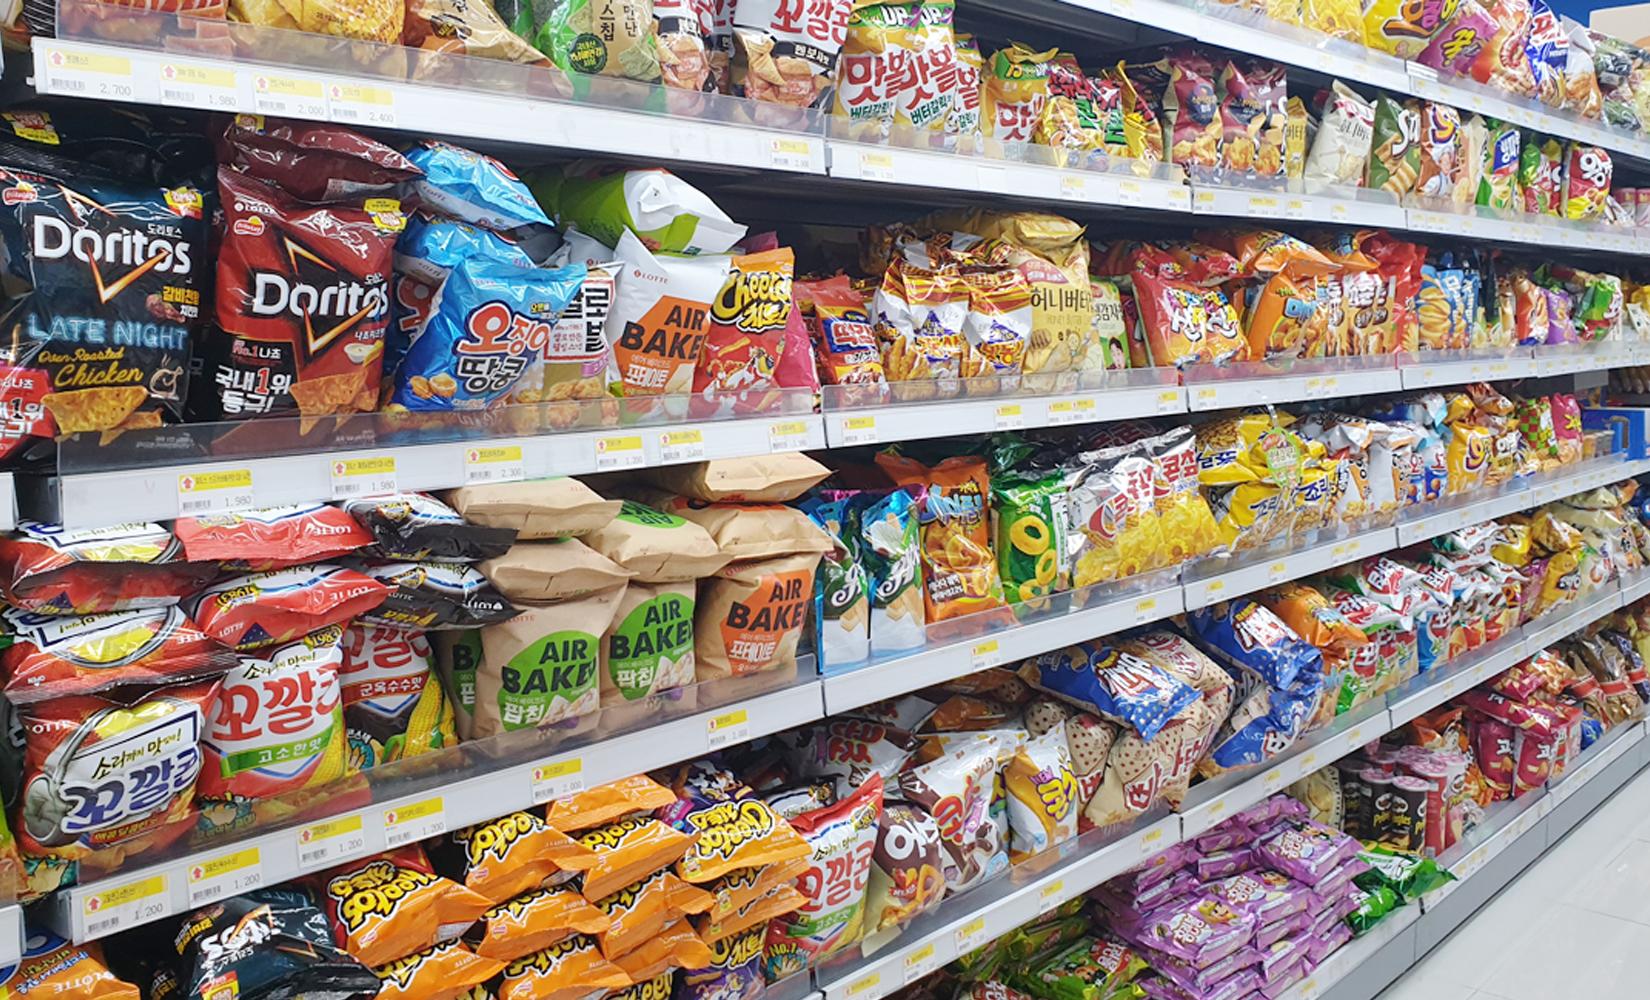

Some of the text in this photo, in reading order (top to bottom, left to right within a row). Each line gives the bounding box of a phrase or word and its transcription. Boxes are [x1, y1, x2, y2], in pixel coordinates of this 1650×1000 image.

[600, 0, 615, 41] 스칩
[881, 6, 908, 26] UP
[850, 101, 893, 118] 버터갈릭
[34, 214, 192, 274] Doritos
[147, 222, 184, 239] 도리토스
[641, 272, 669, 285] LOTTE
[28, 312, 189, 350] LATE NIGHT
[664, 305, 706, 331] AIR
[38, 346, 126, 364] Oven Roasted
[620, 321, 708, 361] BAKE
[54, 360, 145, 388] Chicken
[215, 365, 292, 396] 국내1위
[221, 390, 275, 414] 등급!
[768, 577, 803, 603] AIR
[643, 599, 682, 628] AIR
[726, 601, 805, 632] BAKE
[539, 638, 588, 664] AIR
[610, 617, 694, 660] BAKE
[502, 656, 597, 695] BAKE
[211, 662, 341, 742] 꼬깔콘
[64, 747, 199, 830] 꼬깔콘
[697, 801, 772, 859] Cheetos
[341, 867, 438, 931] heetos
